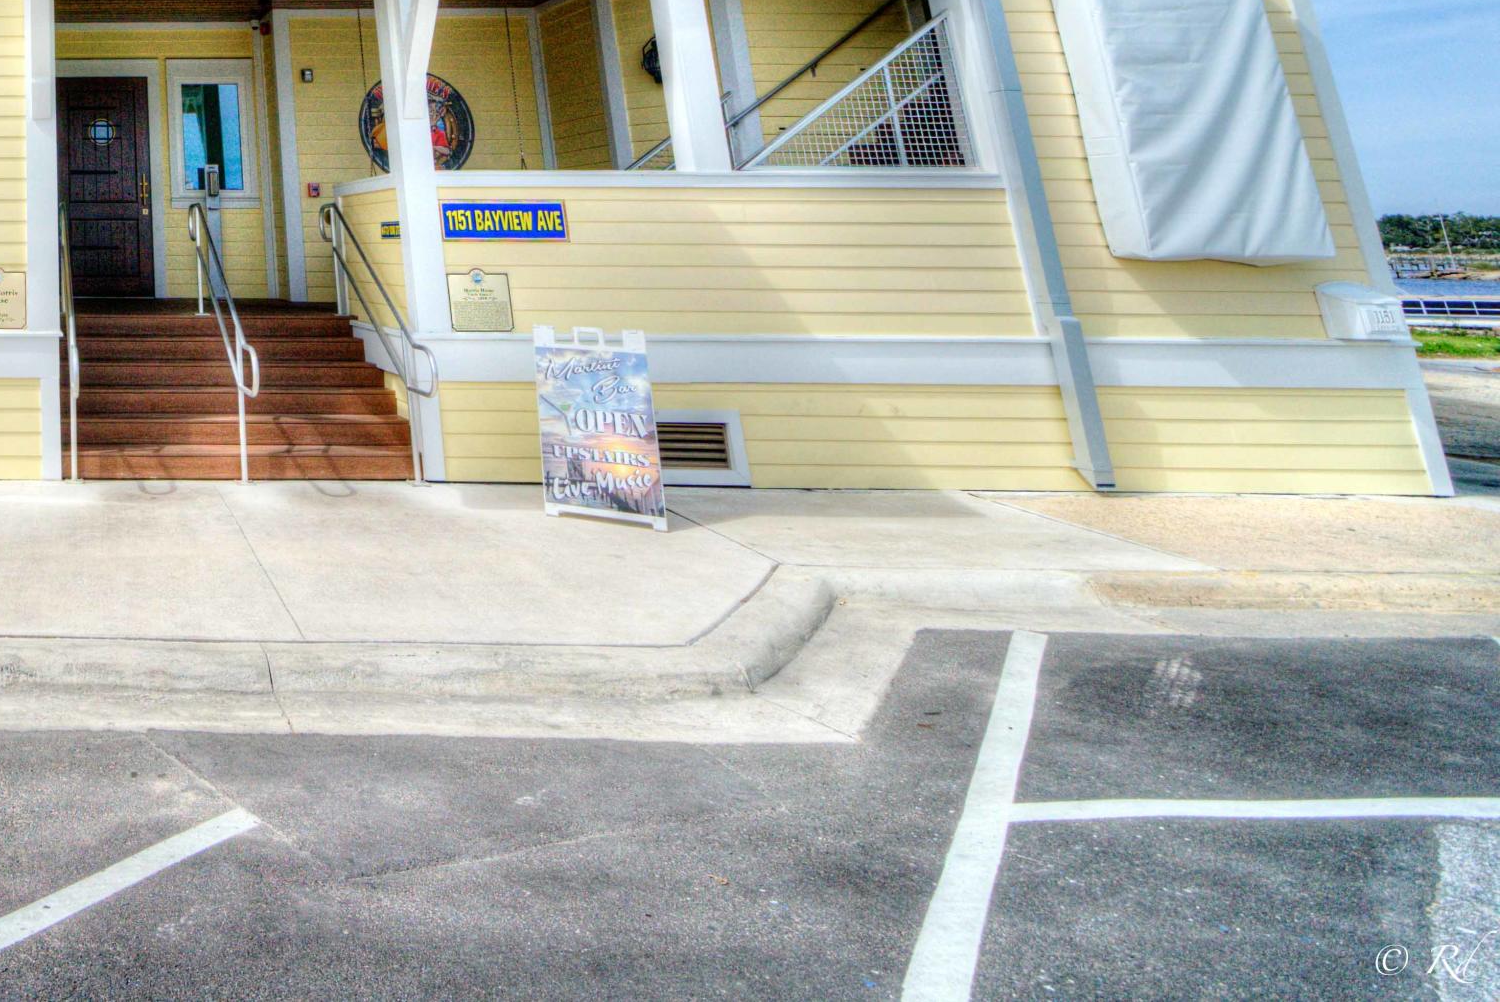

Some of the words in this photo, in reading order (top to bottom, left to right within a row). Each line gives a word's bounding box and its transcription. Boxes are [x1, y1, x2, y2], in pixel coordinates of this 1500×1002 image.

[446, 210, 473, 231] 1151
[474, 210, 533, 231] BAYVIEW
[537, 210, 564, 231] AVE
[591, 375, 636, 405] Bar
[575, 409, 648, 438] OPEN
[553, 445, 651, 468] UPSTAIRS
[595, 469, 652, 495] Music
